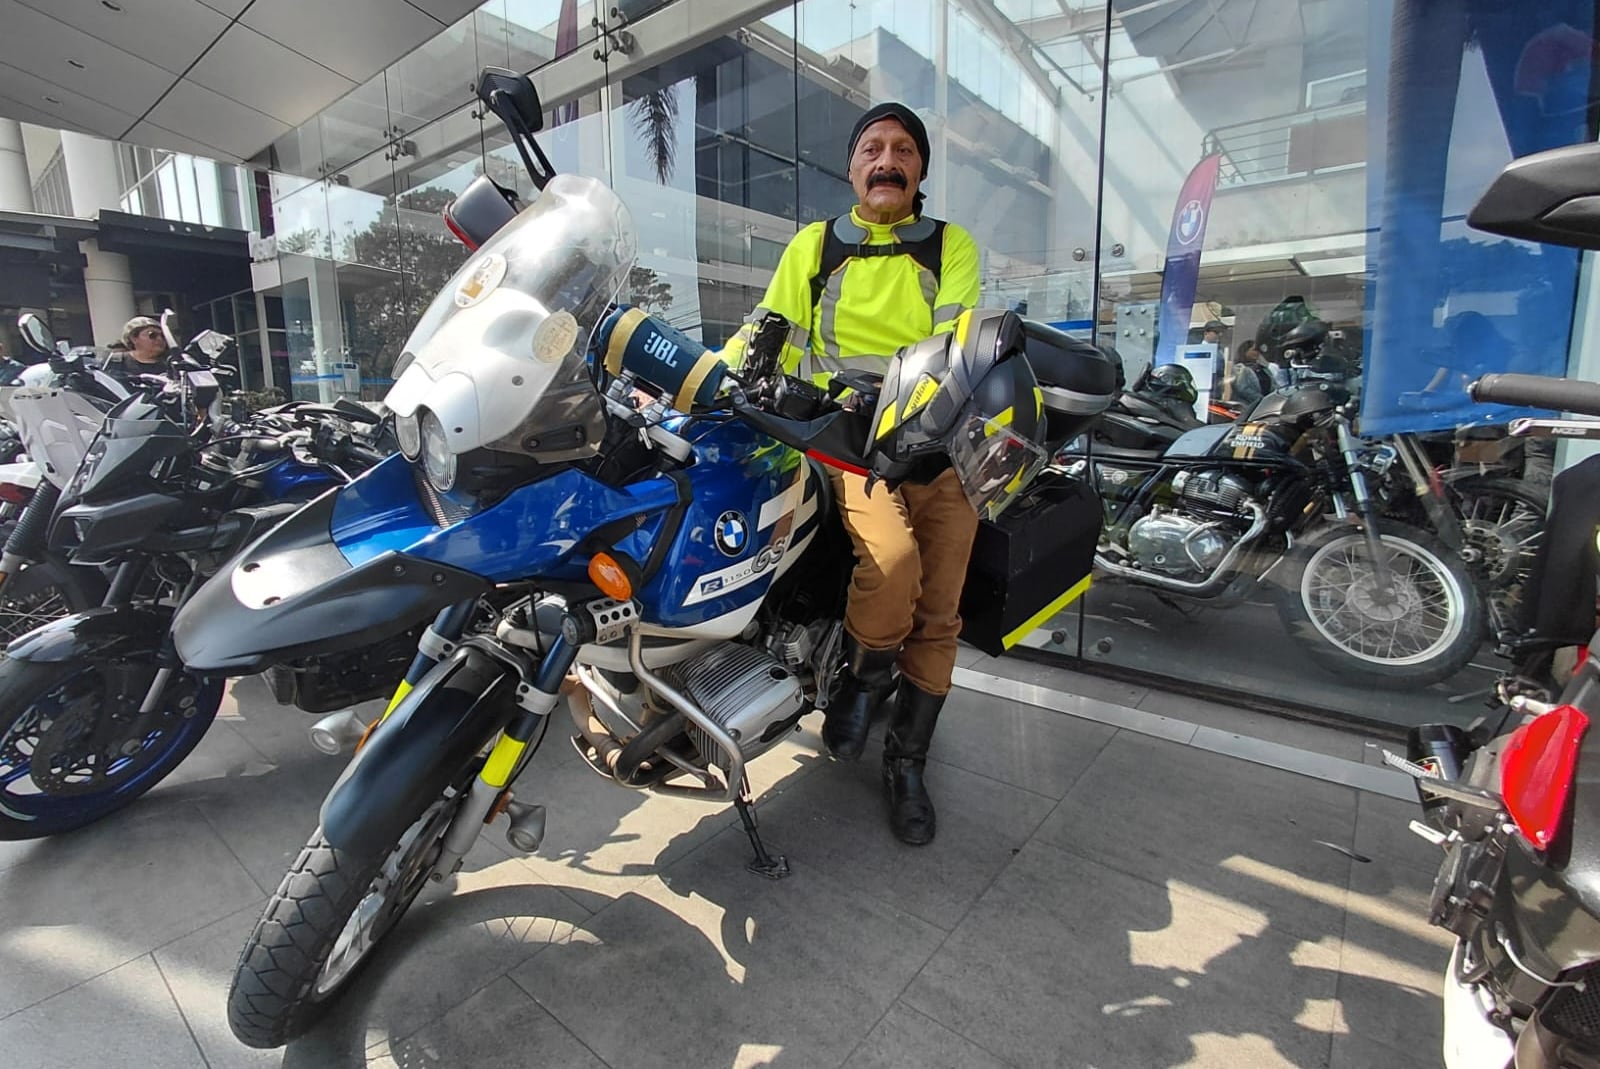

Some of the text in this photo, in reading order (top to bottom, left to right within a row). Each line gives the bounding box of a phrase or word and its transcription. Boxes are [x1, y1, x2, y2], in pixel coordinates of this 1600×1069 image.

[643, 331, 679, 368] JBL
[1230, 440, 1265, 449] ENFIELD
[751, 537, 785, 573] GS
